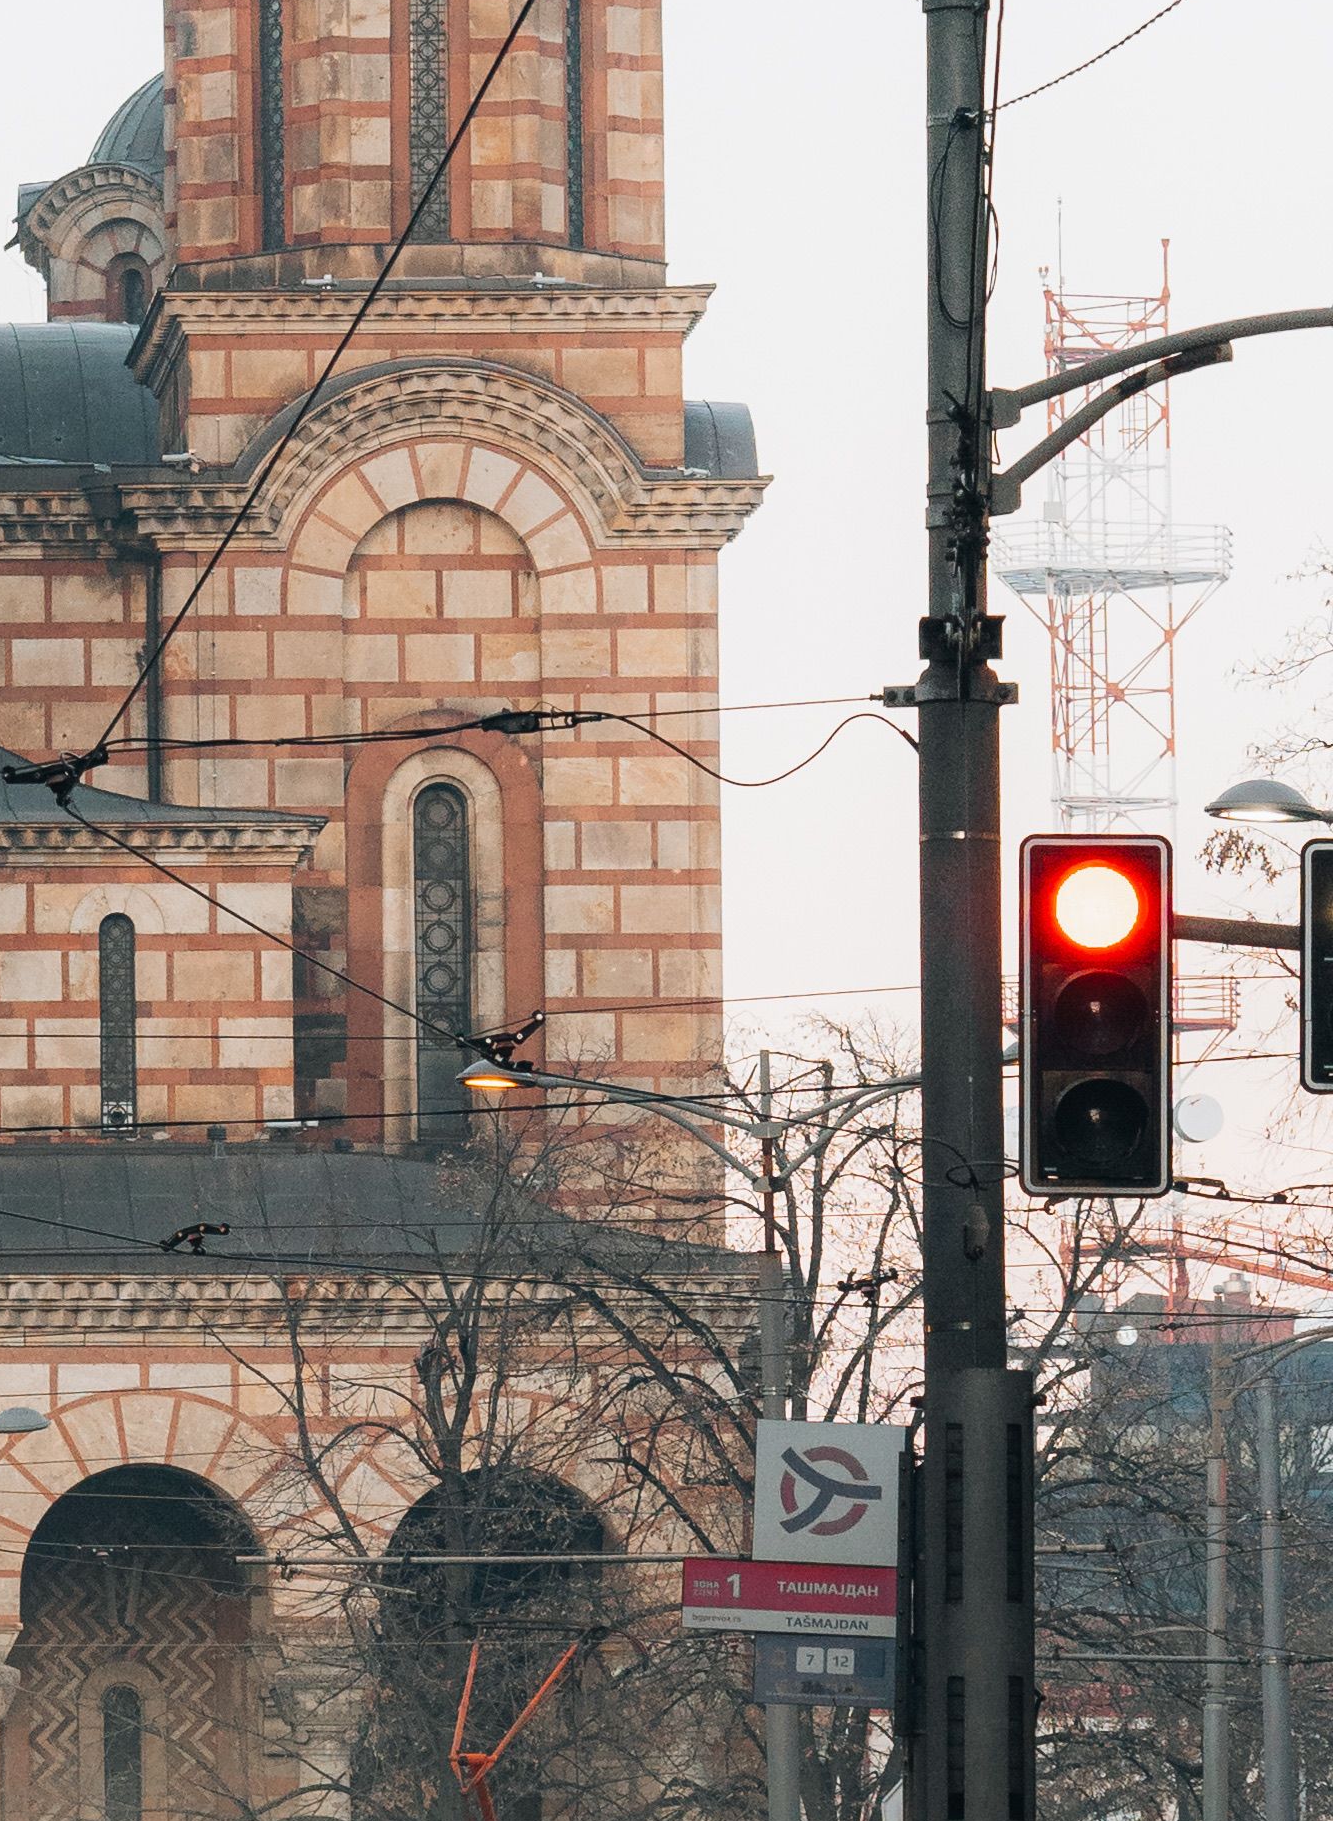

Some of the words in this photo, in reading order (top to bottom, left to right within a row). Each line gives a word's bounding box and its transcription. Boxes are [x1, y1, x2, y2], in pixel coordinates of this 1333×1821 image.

[726, 1573, 742, 1599] 1
[776, 1580, 879, 1599] ТАШМАЈДАН
[785, 1614, 869, 1631] TAŠMAJDAN
[805, 1654, 815, 1666] 7
[832, 1655, 849, 1668] 12
